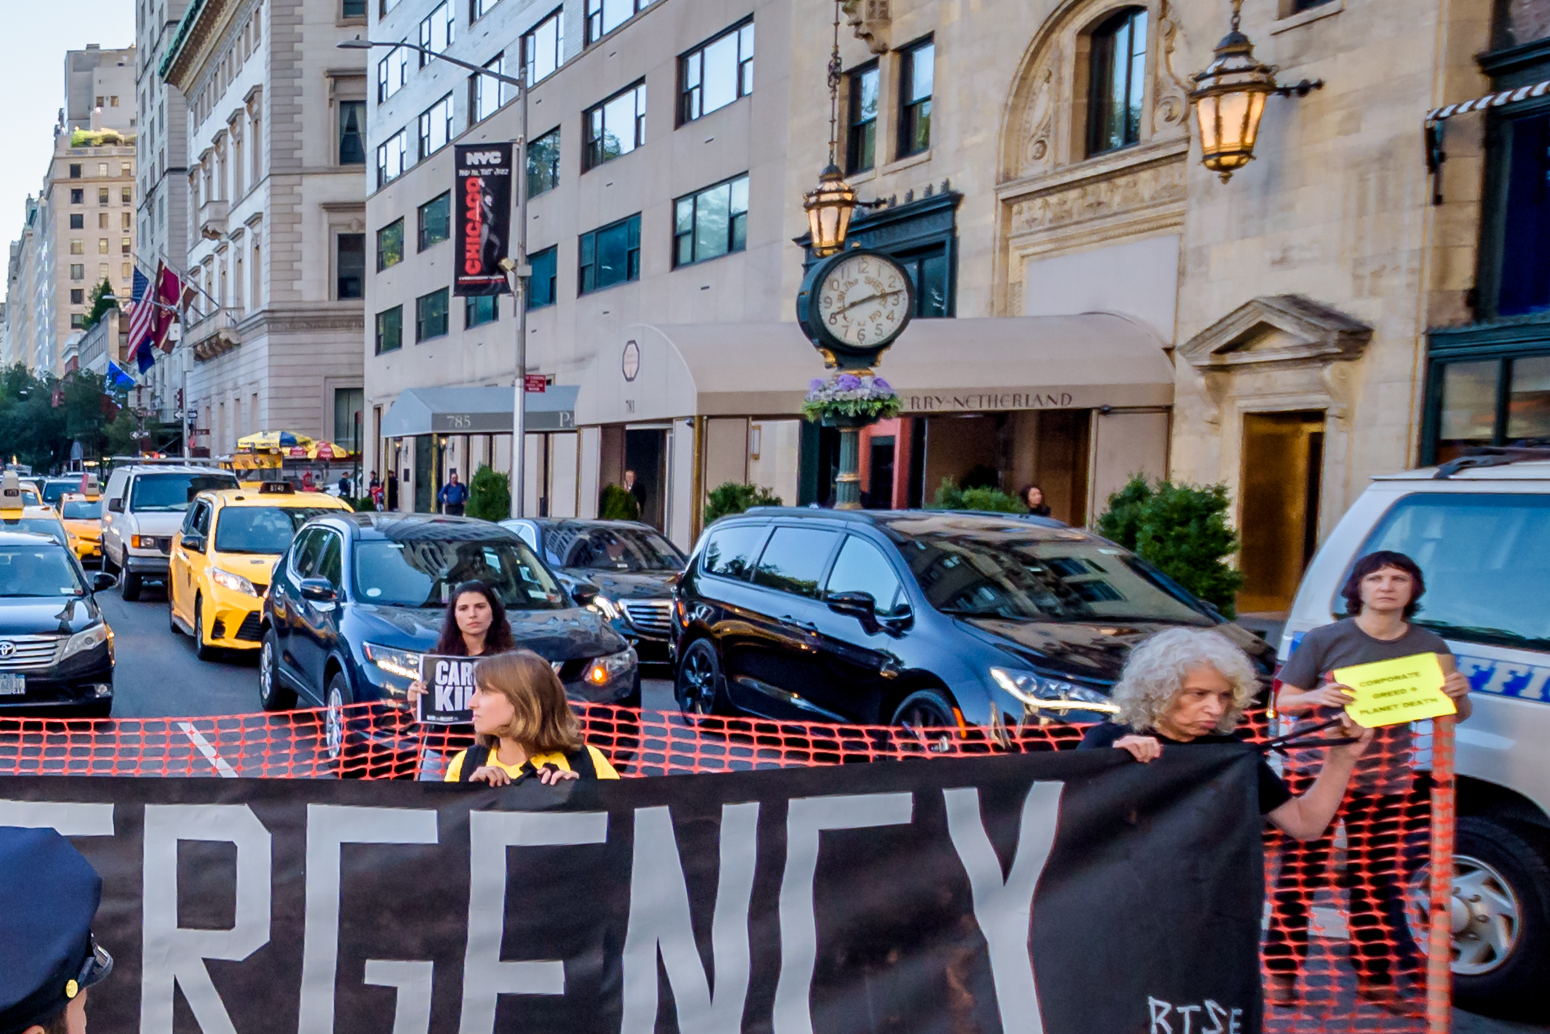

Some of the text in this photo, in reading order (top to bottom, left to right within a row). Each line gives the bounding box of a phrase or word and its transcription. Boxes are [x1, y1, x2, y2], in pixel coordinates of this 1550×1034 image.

[466, 151, 501, 165] NYC
[465, 177, 482, 275] CHICAGO
[857, 261, 869, 275] 12
[447, 415, 471, 428] 785
[1359, 670, 1421, 688] CORPORATE
[1372, 688, 1407, 700] GREED
[1359, 697, 1439, 715] PLANET DEATH
